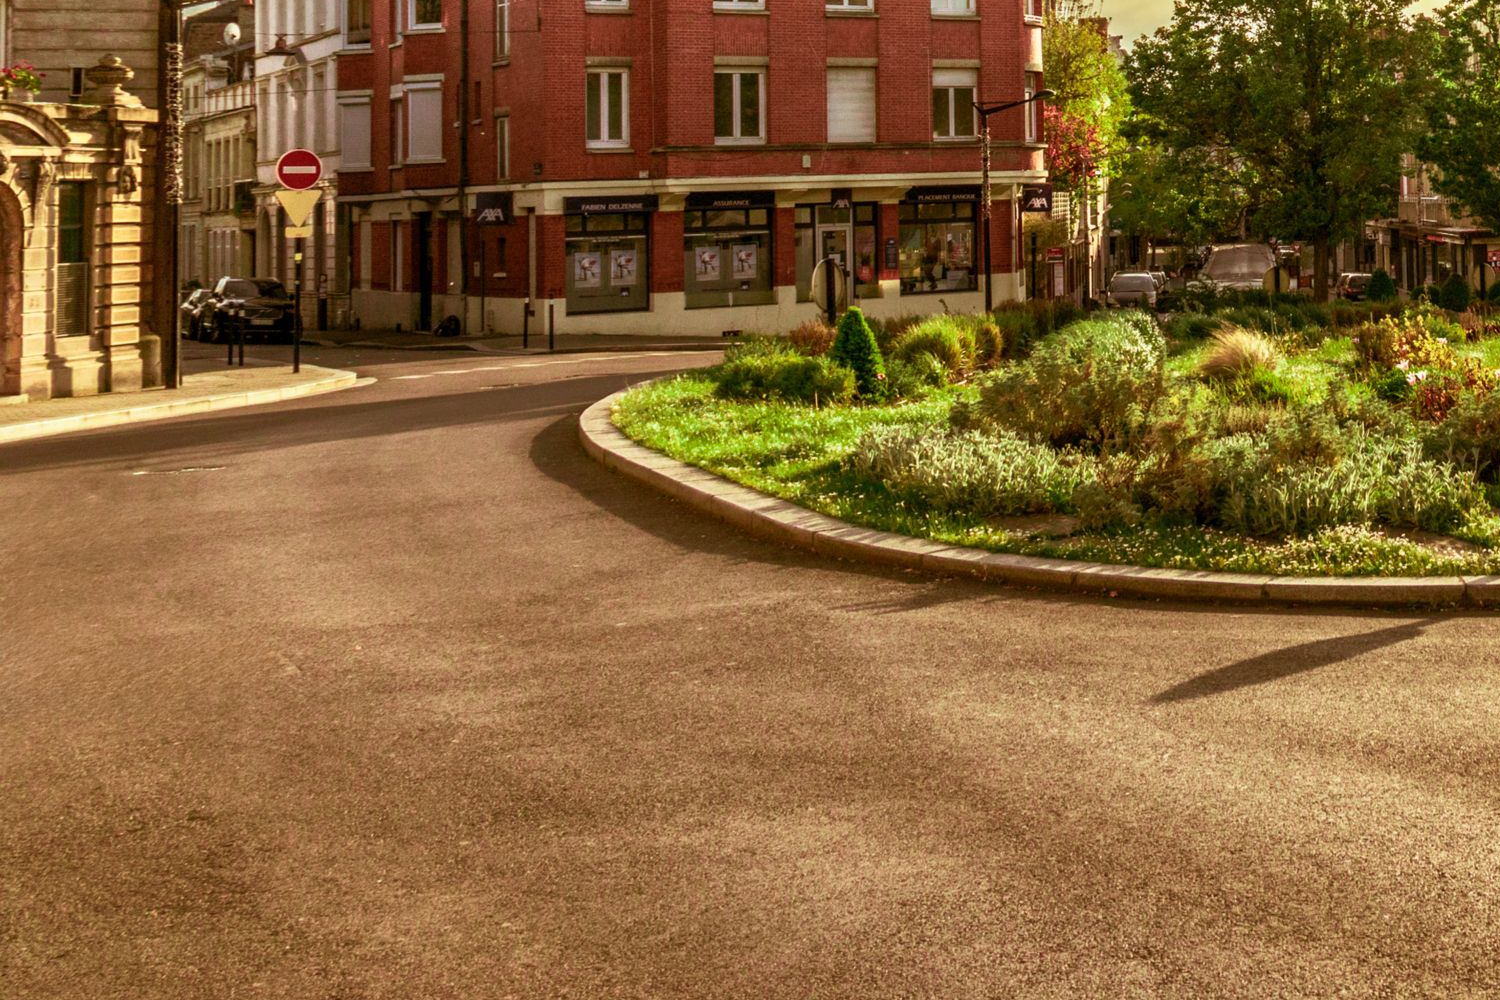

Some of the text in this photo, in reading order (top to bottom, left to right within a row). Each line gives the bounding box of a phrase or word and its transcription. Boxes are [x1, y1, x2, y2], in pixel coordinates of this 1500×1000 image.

[581, 202, 643, 211] FABIEN DELZENNE
[832, 198, 850, 209] AXA
[1026, 197, 1048, 209] AXA
[477, 208, 504, 222] AXA
